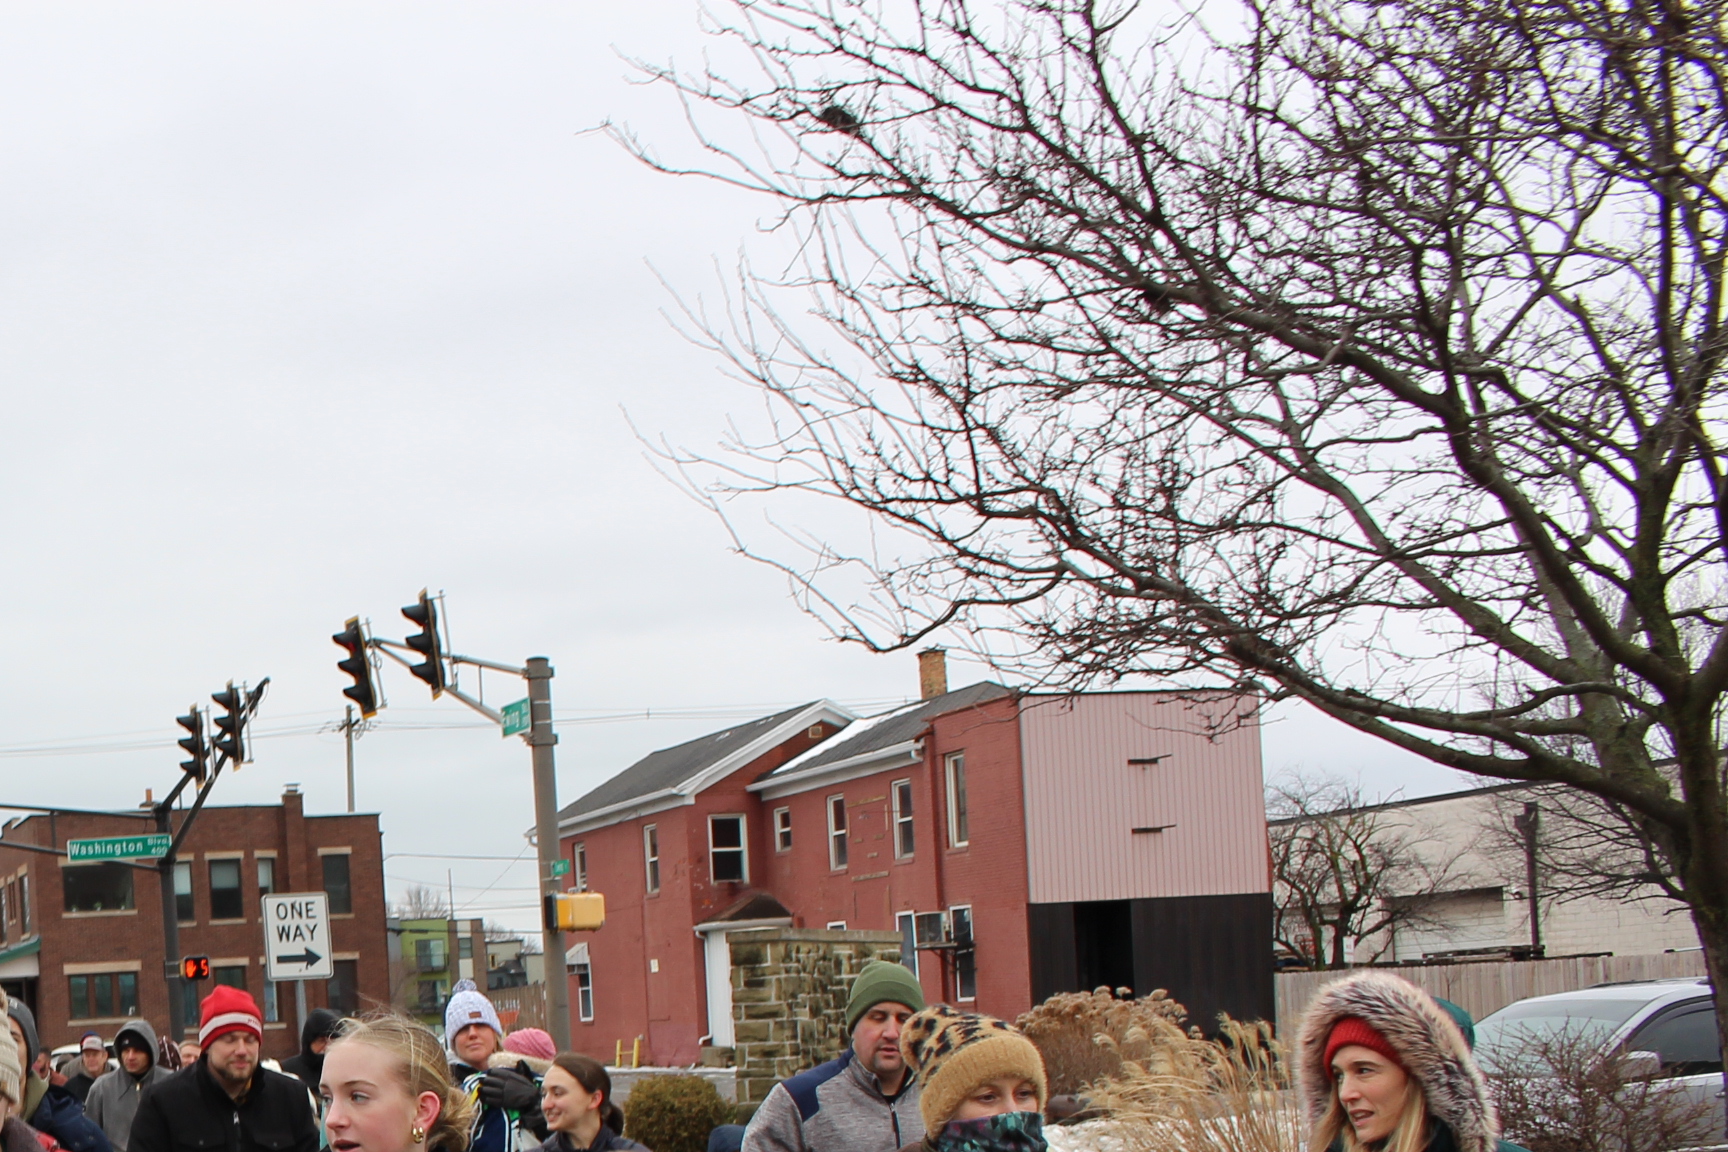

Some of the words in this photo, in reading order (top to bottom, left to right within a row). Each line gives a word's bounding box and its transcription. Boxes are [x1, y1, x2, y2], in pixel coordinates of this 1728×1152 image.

[71, 841, 143, 856] Washington
[276, 901, 317, 920] ONE
[277, 924, 317, 943] WAY
[200, 959, 208, 977] 5
